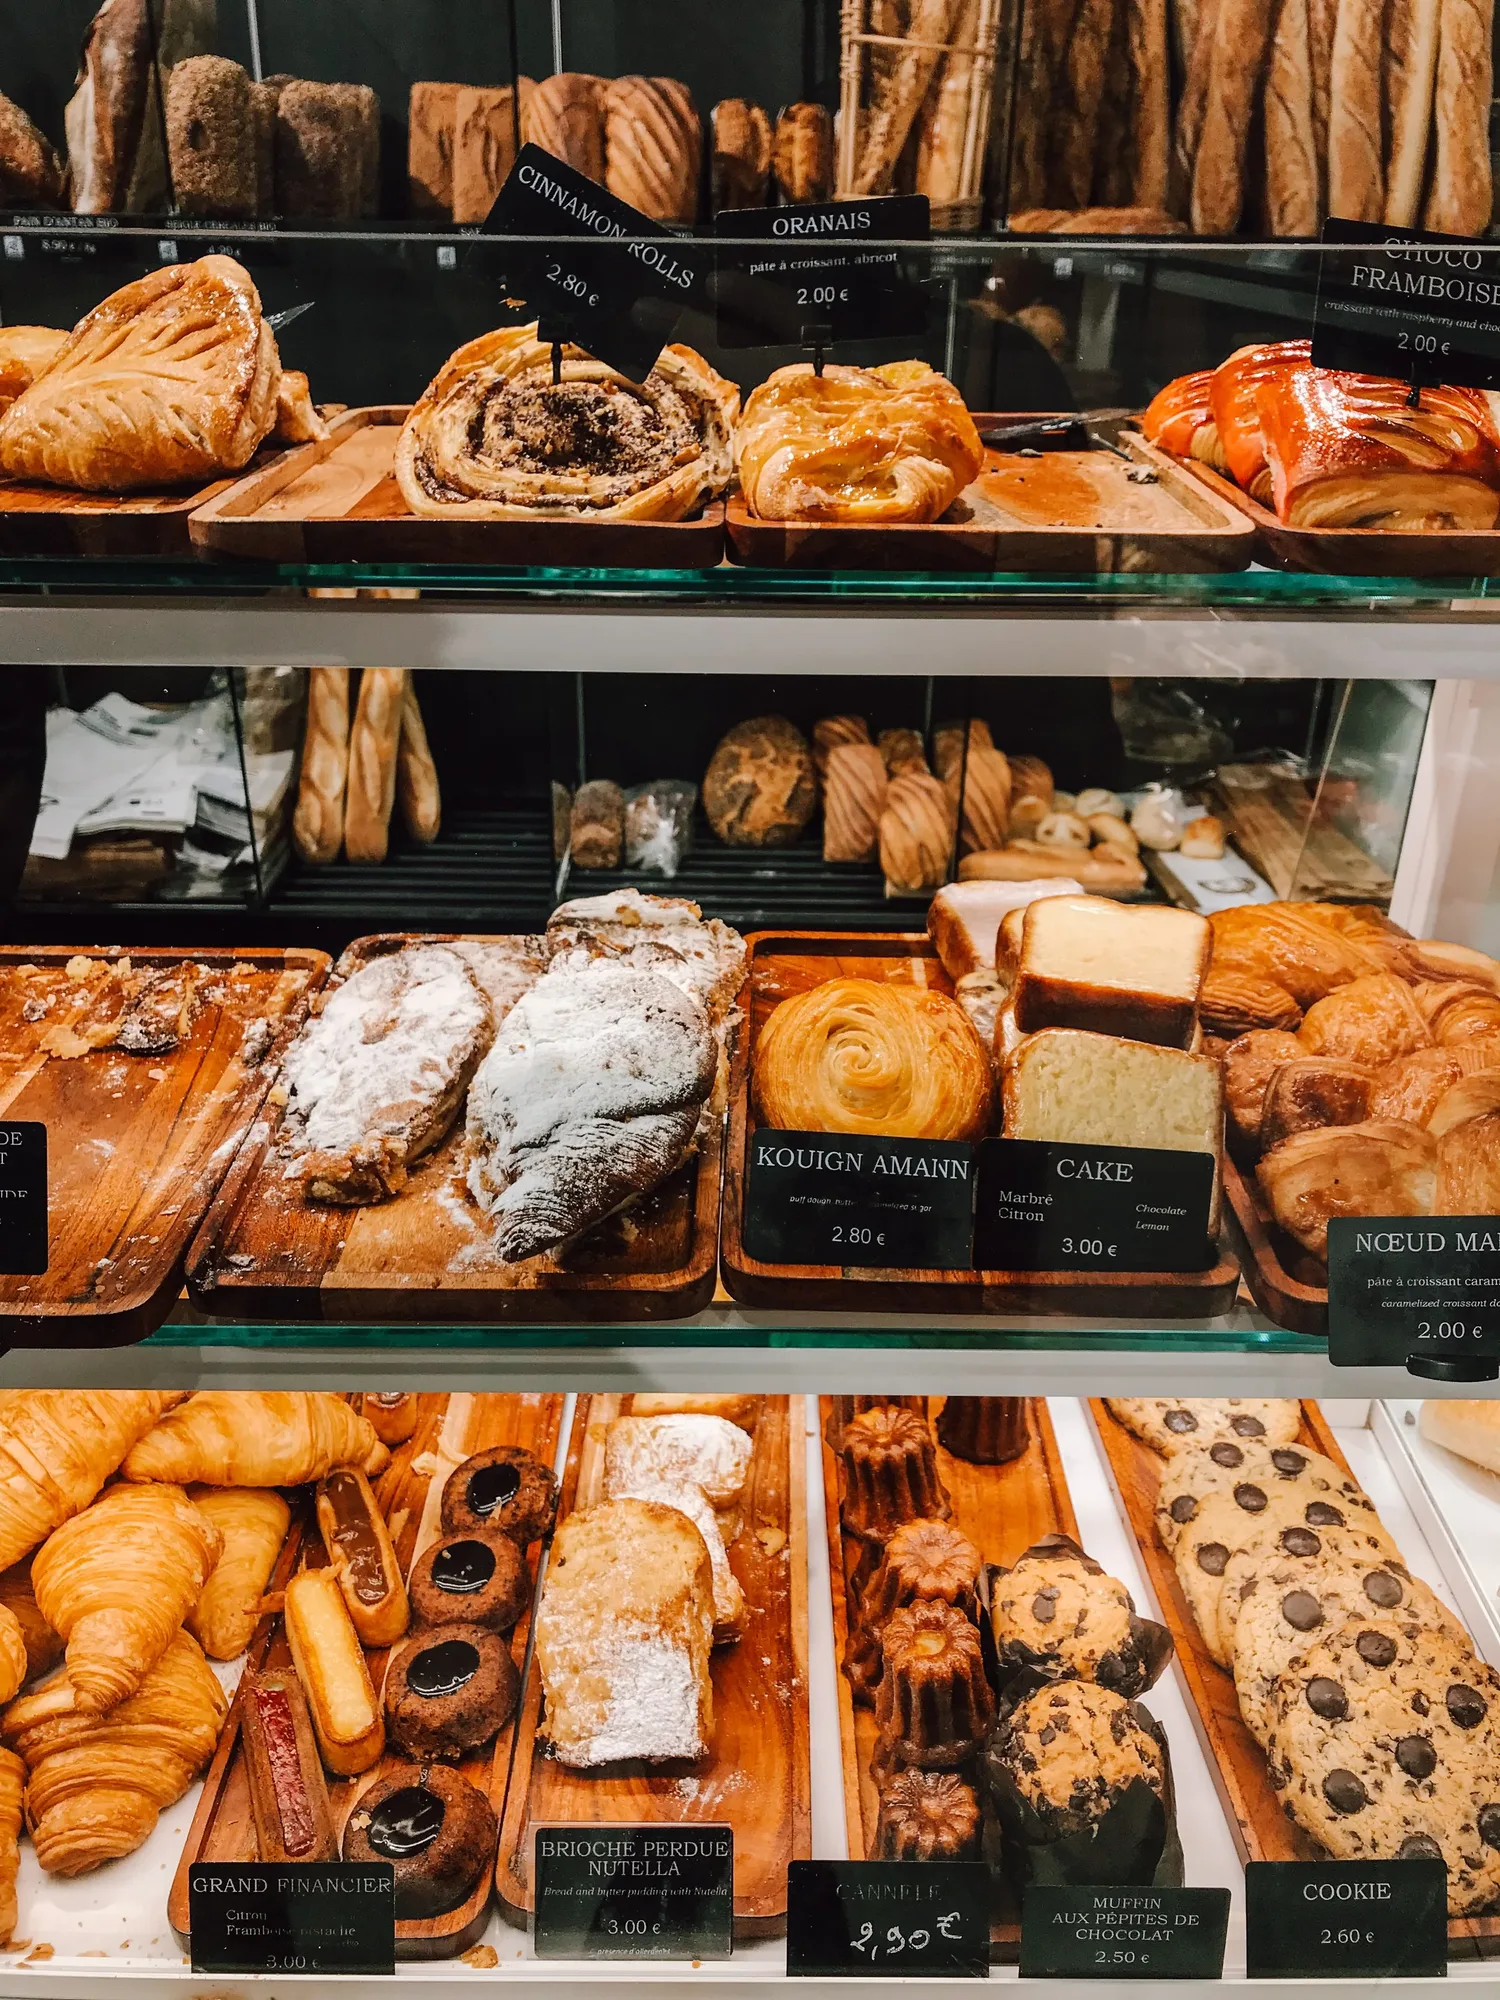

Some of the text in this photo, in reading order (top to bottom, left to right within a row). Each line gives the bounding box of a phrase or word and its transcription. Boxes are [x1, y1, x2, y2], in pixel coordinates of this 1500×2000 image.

[518, 165, 695, 289] CINNAMON ROLLS
[772, 212, 871, 236] ORANAIS
[1385, 237, 1482, 270] CHOCO
[750, 260, 776, 275] pâte
[779, 259, 787, 271] à
[854, 252, 897, 265] abricot
[546, 263, 600, 307] 2.80 €
[797, 286, 848, 305] 2.00 €
[1324, 301, 1373, 316] croissant
[1375, 306, 1400, 319] with
[1456, 319, 1478, 329] and
[1397, 332, 1451, 355] 2.00 €
[757, 1146, 970, 1180] KOUIGN AMANN
[1056, 1158, 1134, 1183] CAKE
[999, 1190, 1053, 1206] Marbré
[998, 1207, 1045, 1222] Citron
[1135, 1203, 1187, 1216] Chocolate
[1135, 1220, 1170, 1231] Lemon
[831, 1226, 886, 1246] 2.80 €
[1355, 1232, 1500, 1253] NŒUD MA
[1061, 1237, 1118, 1257] 3.00 €
[1367, 1276, 1393, 1289] pâte
[1396, 1276, 1403, 1287] à
[1407, 1276, 1461, 1287] croissant
[1381, 1299, 1440, 1308] caramelized
[1442, 1299, 1487, 1308] croissant
[1417, 1322, 1483, 1339] 2.00 €
[541, 1841, 729, 1857] BRIOCHE PERDUE
[588, 1860, 681, 1877] NUTELLA
[193, 1877, 392, 1893] GRAND FINANCIER
[544, 1886, 728, 1898] Bread and butter pudding with Nutella
[1303, 1882, 1392, 1901] COOKIE
[1093, 1897, 1162, 1909] MUFFIN
[225, 1909, 267, 1921] Citron
[1052, 1911, 1200, 1926] AUX PÉPITES DE
[608, 1919, 661, 1935] 3.00 €
[1075, 1928, 1174, 1942] CHOCOLAT
[850, 1911, 962, 1960] 2,90 €
[1320, 1928, 1375, 1944] 2.60 €
[266, 1955, 322, 1969] 3.00 €
[1095, 1951, 1150, 1964] 2.50 €
